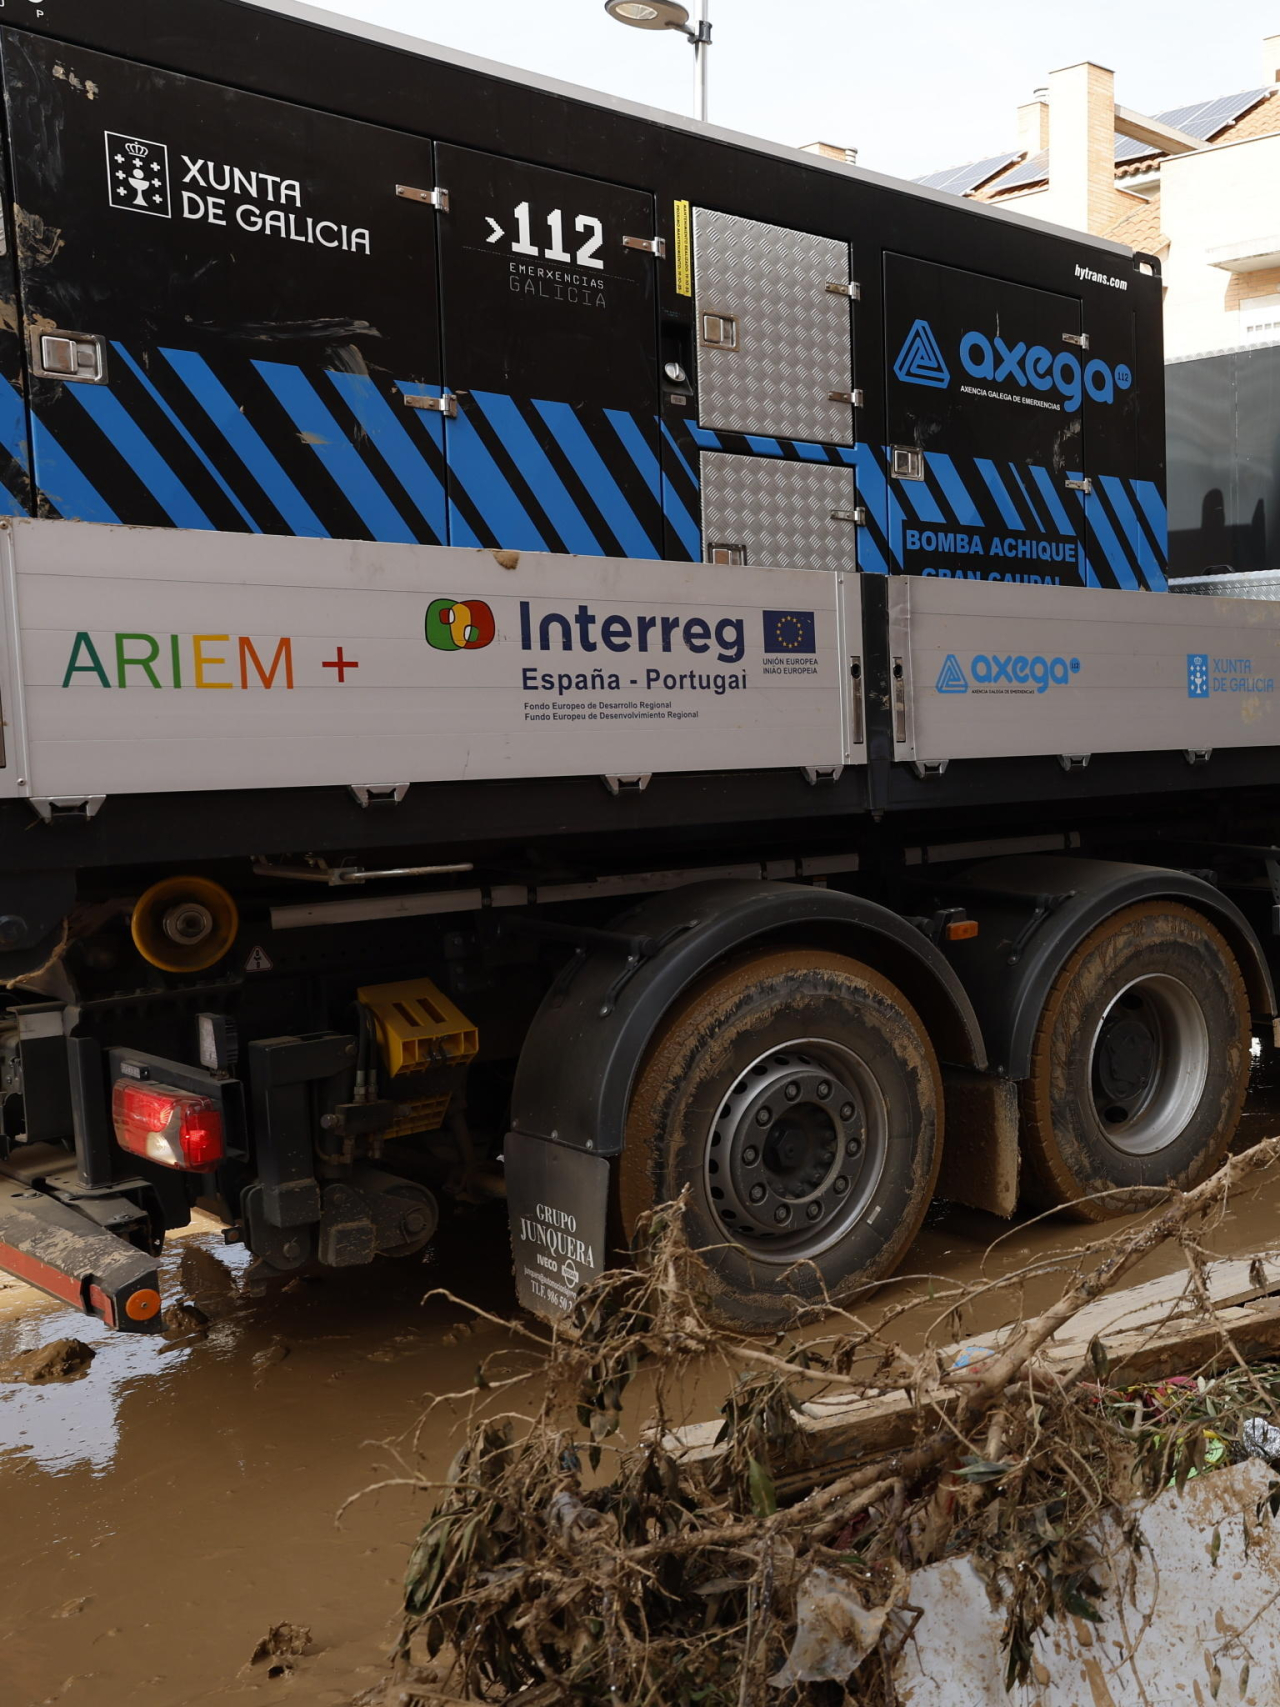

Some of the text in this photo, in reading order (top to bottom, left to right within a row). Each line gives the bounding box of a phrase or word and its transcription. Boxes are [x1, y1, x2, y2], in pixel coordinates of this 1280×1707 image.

[180, 154, 301, 207] XUNTA
[181, 190, 371, 254] DE GALICIA
[511, 201, 604, 270] 112
[509, 262, 604, 290] EMERXENCIAS
[1074, 263, 1128, 291] hytrans.com
[509, 275, 606, 309] GALICIA
[959, 331, 1129, 413] axega 112
[960, 385, 1061, 411] AXENCIA GALEGA DE EMERXENCIAS
[906, 529, 1076, 563] BOMBA ACHIQUE
[519, 601, 745, 664] Interreg
[61, 631, 294, 689] ARIEM
[762, 656, 818, 665] UNIÓN EUROPEA
[783, 667, 818, 675] EUROPEIA
[971, 654, 1069, 694] axega
[1213, 658, 1252, 674] XUNTA
[522, 667, 620, 696] España
[1213, 677, 1274, 692] DE GALICIA
[524, 702, 550, 710] Fondo
[552, 702, 586, 711] Europeo
[599, 701, 638, 709] Desarrollo
[639, 701, 672, 710] Regional
[524, 710, 699, 721] Fundo Europeu de Desenvolvimiento Regional
[536, 1203, 576, 1233] GRUPO
[520, 1217, 595, 1269] JUNQUERA
[536, 1253, 558, 1272] IVECO
[530, 1280, 546, 1299] TLF.
[546, 1289, 559, 1306] 986
